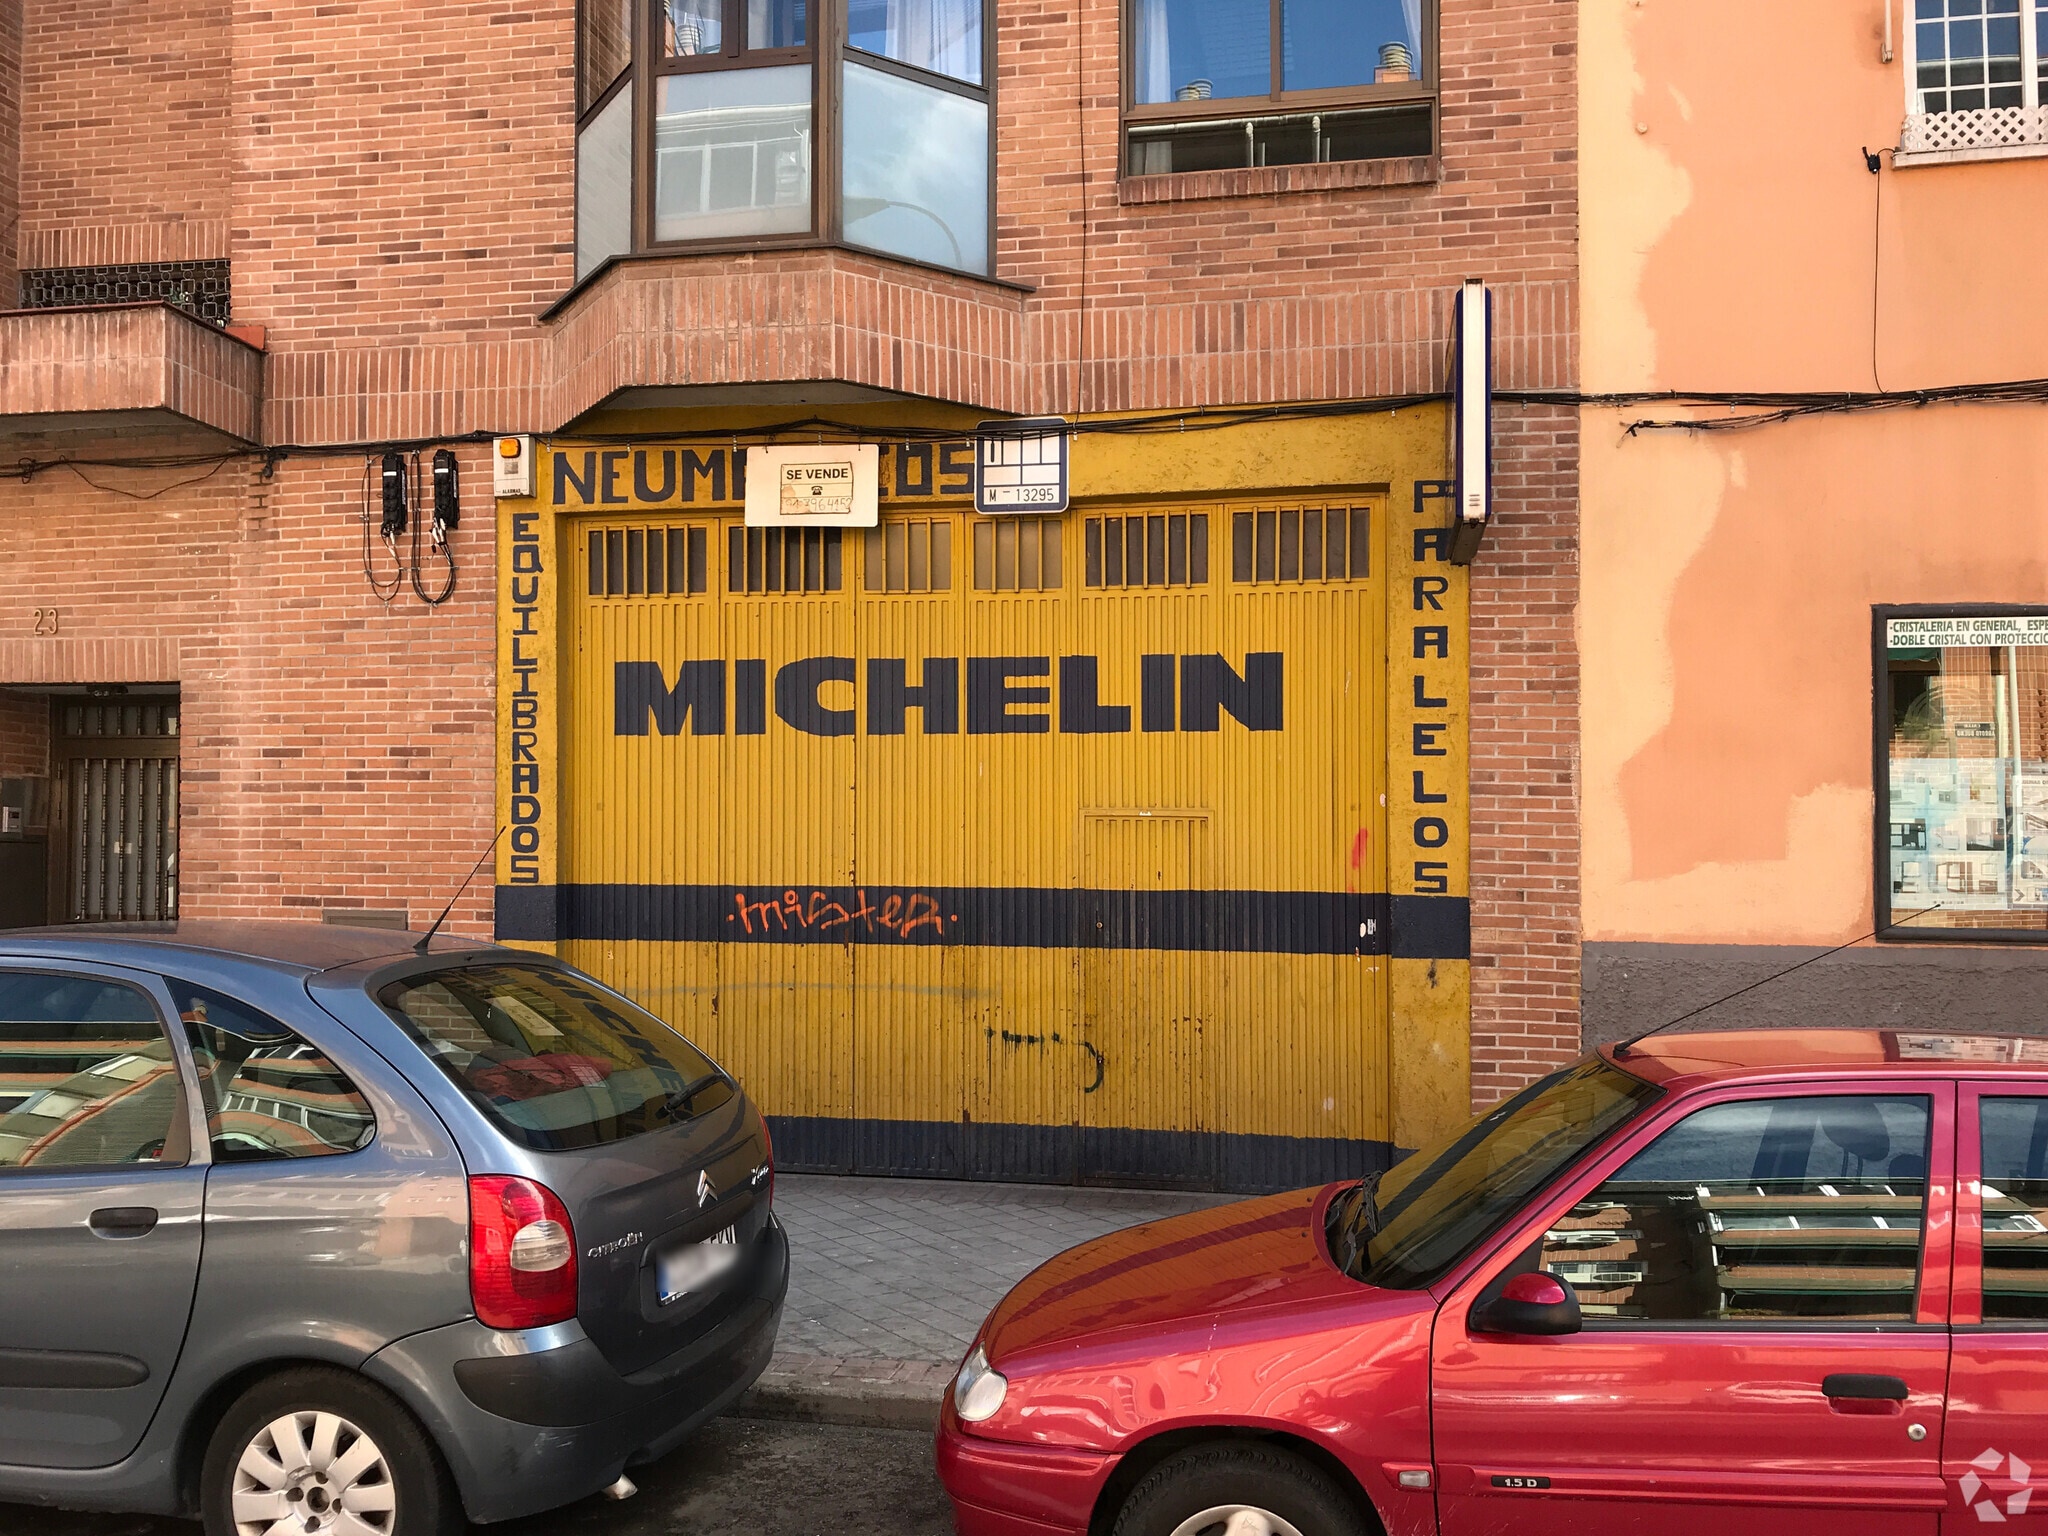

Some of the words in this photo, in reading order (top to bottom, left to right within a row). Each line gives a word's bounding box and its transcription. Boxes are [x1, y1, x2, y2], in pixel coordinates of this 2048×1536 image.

[553, 443, 974, 505] NEUMOS
[786, 470, 802, 480] SE
[806, 468, 848, 479] VENDE
[33, 608, 58, 636] 23
[1893, 621, 1953, 632] CRISTALERIA
[1956, 620, 1970, 631] EN
[1973, 619, 2021, 632] GENERAL,
[1893, 634, 1926, 646] DOBLE
[1928, 634, 1967, 645] CRISTAL
[1970, 633, 1992, 645] CON
[511, 512, 544, 884] EQUILIBRADOS
[614, 651, 1284, 737] MICHELIN
[1413, 480, 1450, 894] PARALELOS
[587, 1231, 643, 1259] CITROËN
[1505, 1478, 1523, 1488] 1.5
[1526, 1478, 1538, 1488] D
